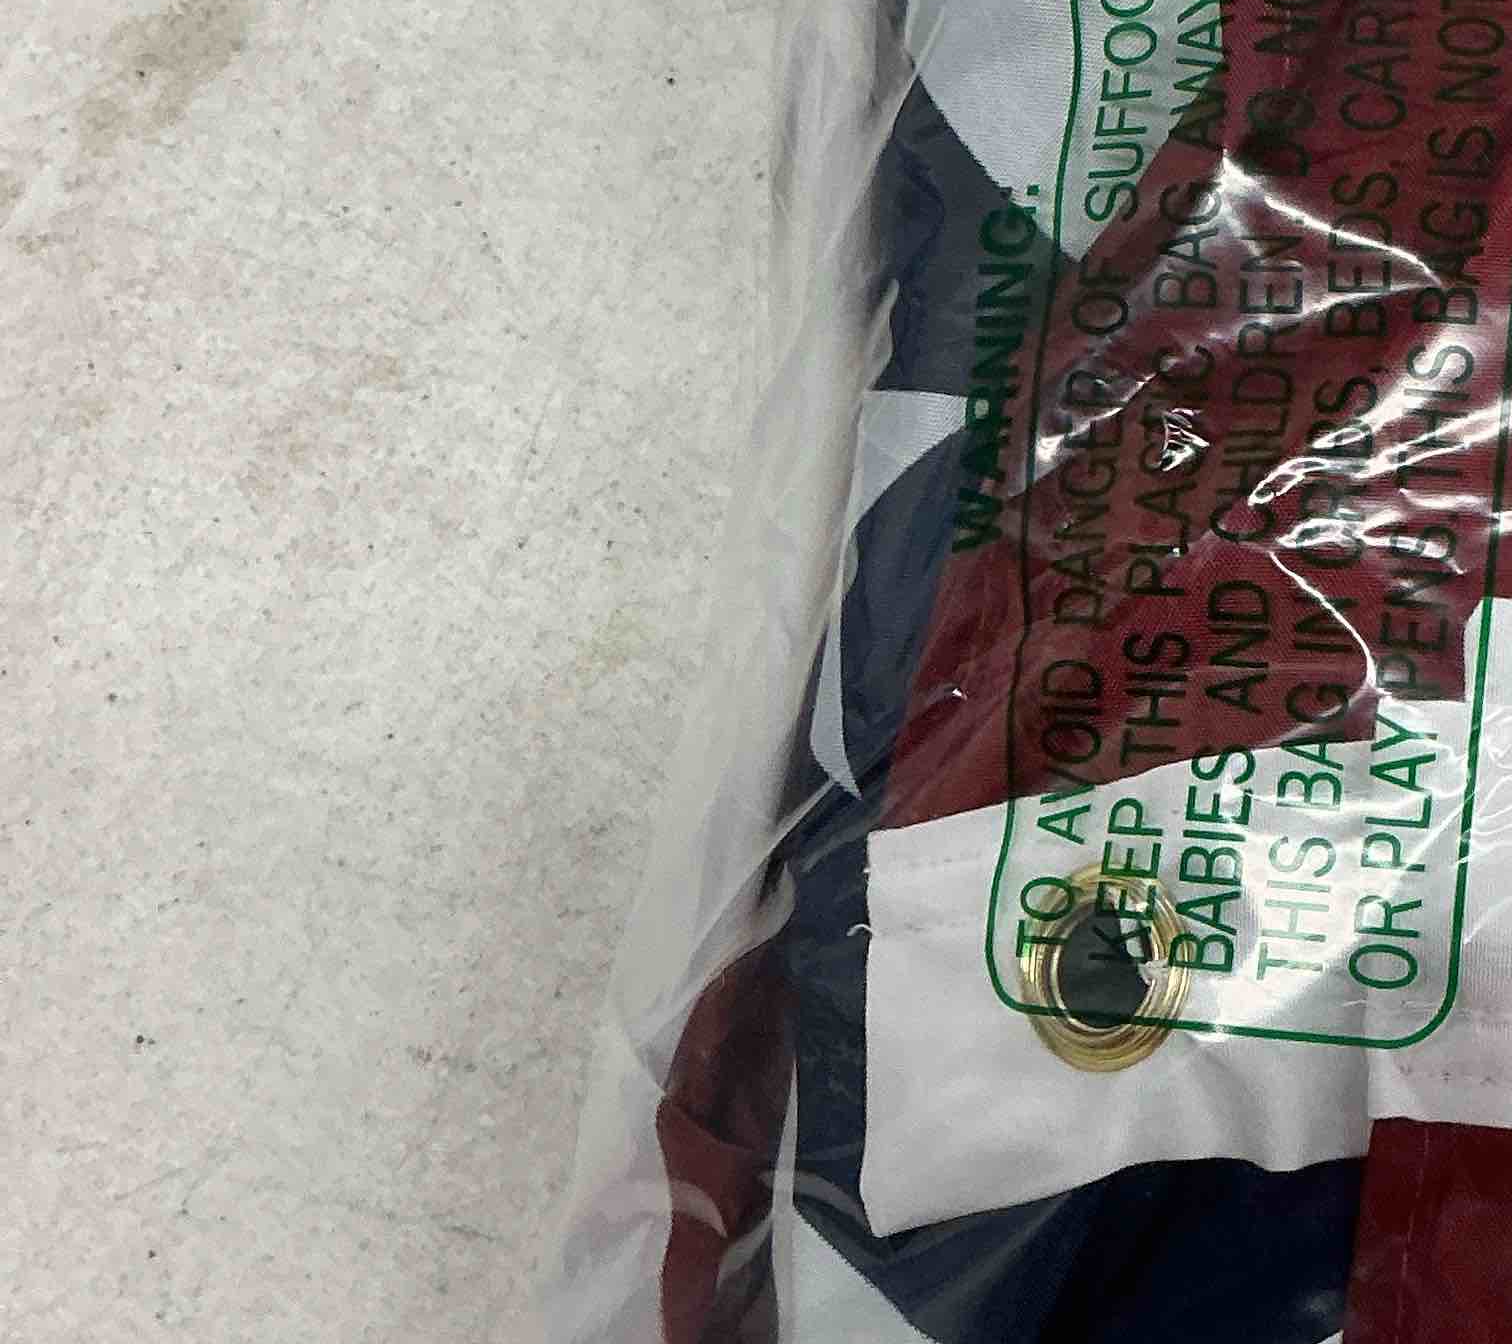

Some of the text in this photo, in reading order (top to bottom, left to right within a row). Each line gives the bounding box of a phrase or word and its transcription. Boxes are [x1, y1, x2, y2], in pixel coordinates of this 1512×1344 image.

[1241, 87, 1315, 177] DO
[1426, 125, 1492, 181] IS
[1072, 251, 1129, 336] OF
[1155, 181, 1221, 312] BAG
[1326, 160, 1406, 338] BEDS,
[1409, 200, 1483, 325] BAG
[1129, 345, 1215, 597] PLASTIC
[1394, 346, 1475, 487] THIS
[1053, 369, 1127, 626] DANGER
[1207, 579, 1271, 715] AND
[1291, 598, 1361, 653] IN
[1036, 660, 1103, 845] AVOID
[1119, 632, 1191, 766] THIS
[1275, 683, 1352, 807] BAG
[1168, 748, 1254, 973] BABIES
[1362, 717, 1438, 871] PLAY
[1016, 877, 1073, 958] TO
[1089, 797, 1164, 964] KEEP
[1256, 836, 1338, 981] THIS
[1348, 896, 1424, 990] OR
